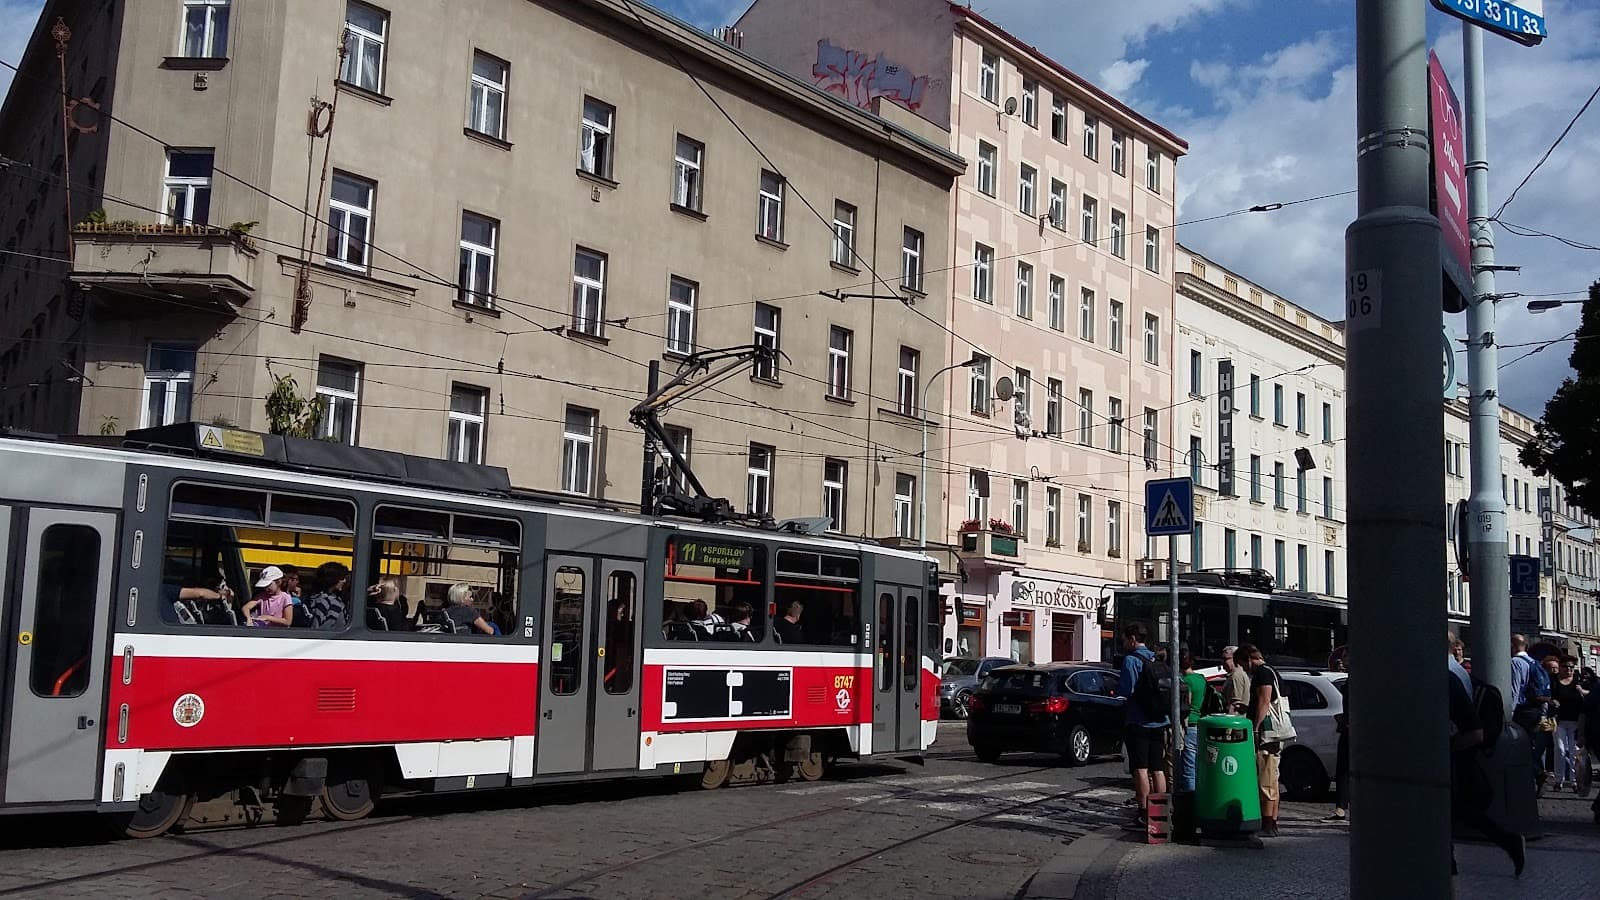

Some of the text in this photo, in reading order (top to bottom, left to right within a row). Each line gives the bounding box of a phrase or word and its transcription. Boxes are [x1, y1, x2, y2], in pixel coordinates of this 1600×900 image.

[1457, 0, 1540, 34] 31 33 11 33
[1349, 295, 1372, 318] 06
[1219, 373, 1232, 484] HOTEL
[1541, 495, 1553, 569] HOTEL
[682, 543, 697, 562] 11
[1516, 562, 1532, 584] P
[1035, 590, 1101, 611] HOROSKOP
[834, 675, 855, 689] 8747
